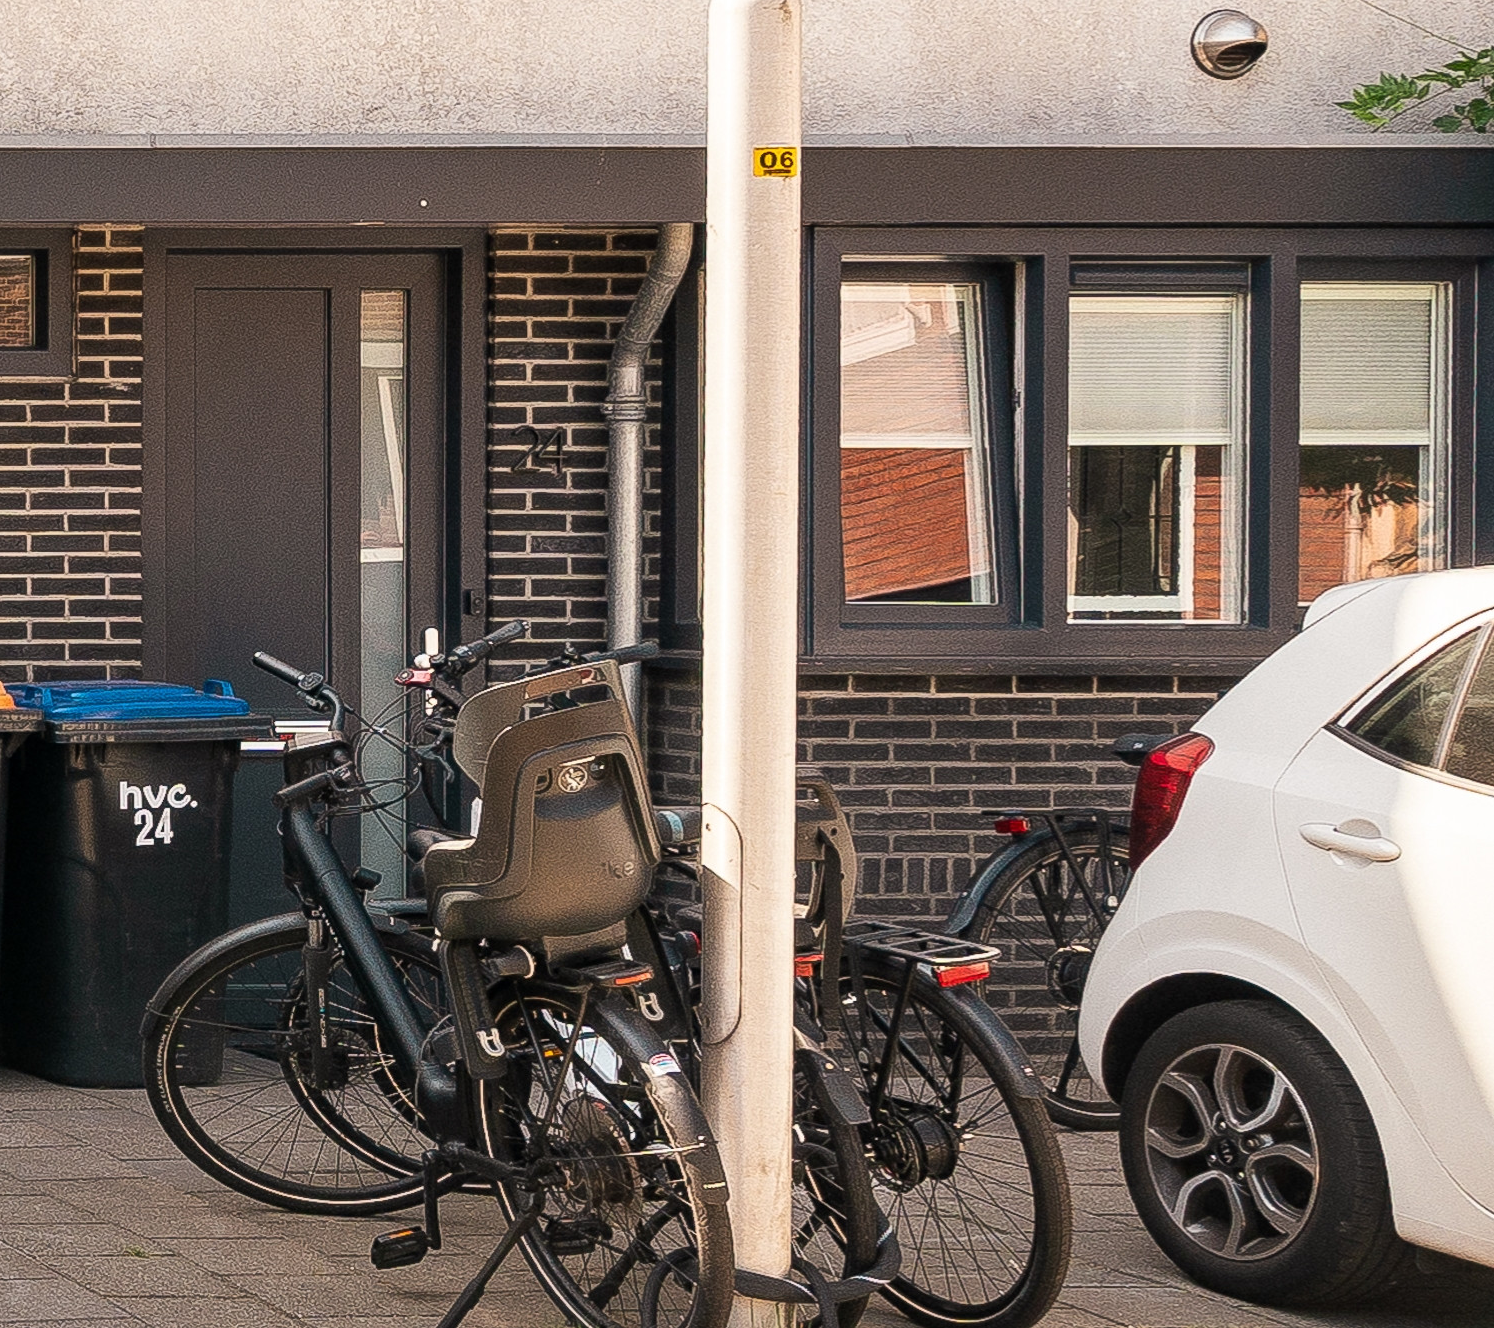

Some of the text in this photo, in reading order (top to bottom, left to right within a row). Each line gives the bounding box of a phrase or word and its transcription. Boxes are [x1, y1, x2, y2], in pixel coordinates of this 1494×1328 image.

[759, 151, 794, 169] 06
[119, 781, 198, 810] hvc.
[134, 808, 174, 846] 24
